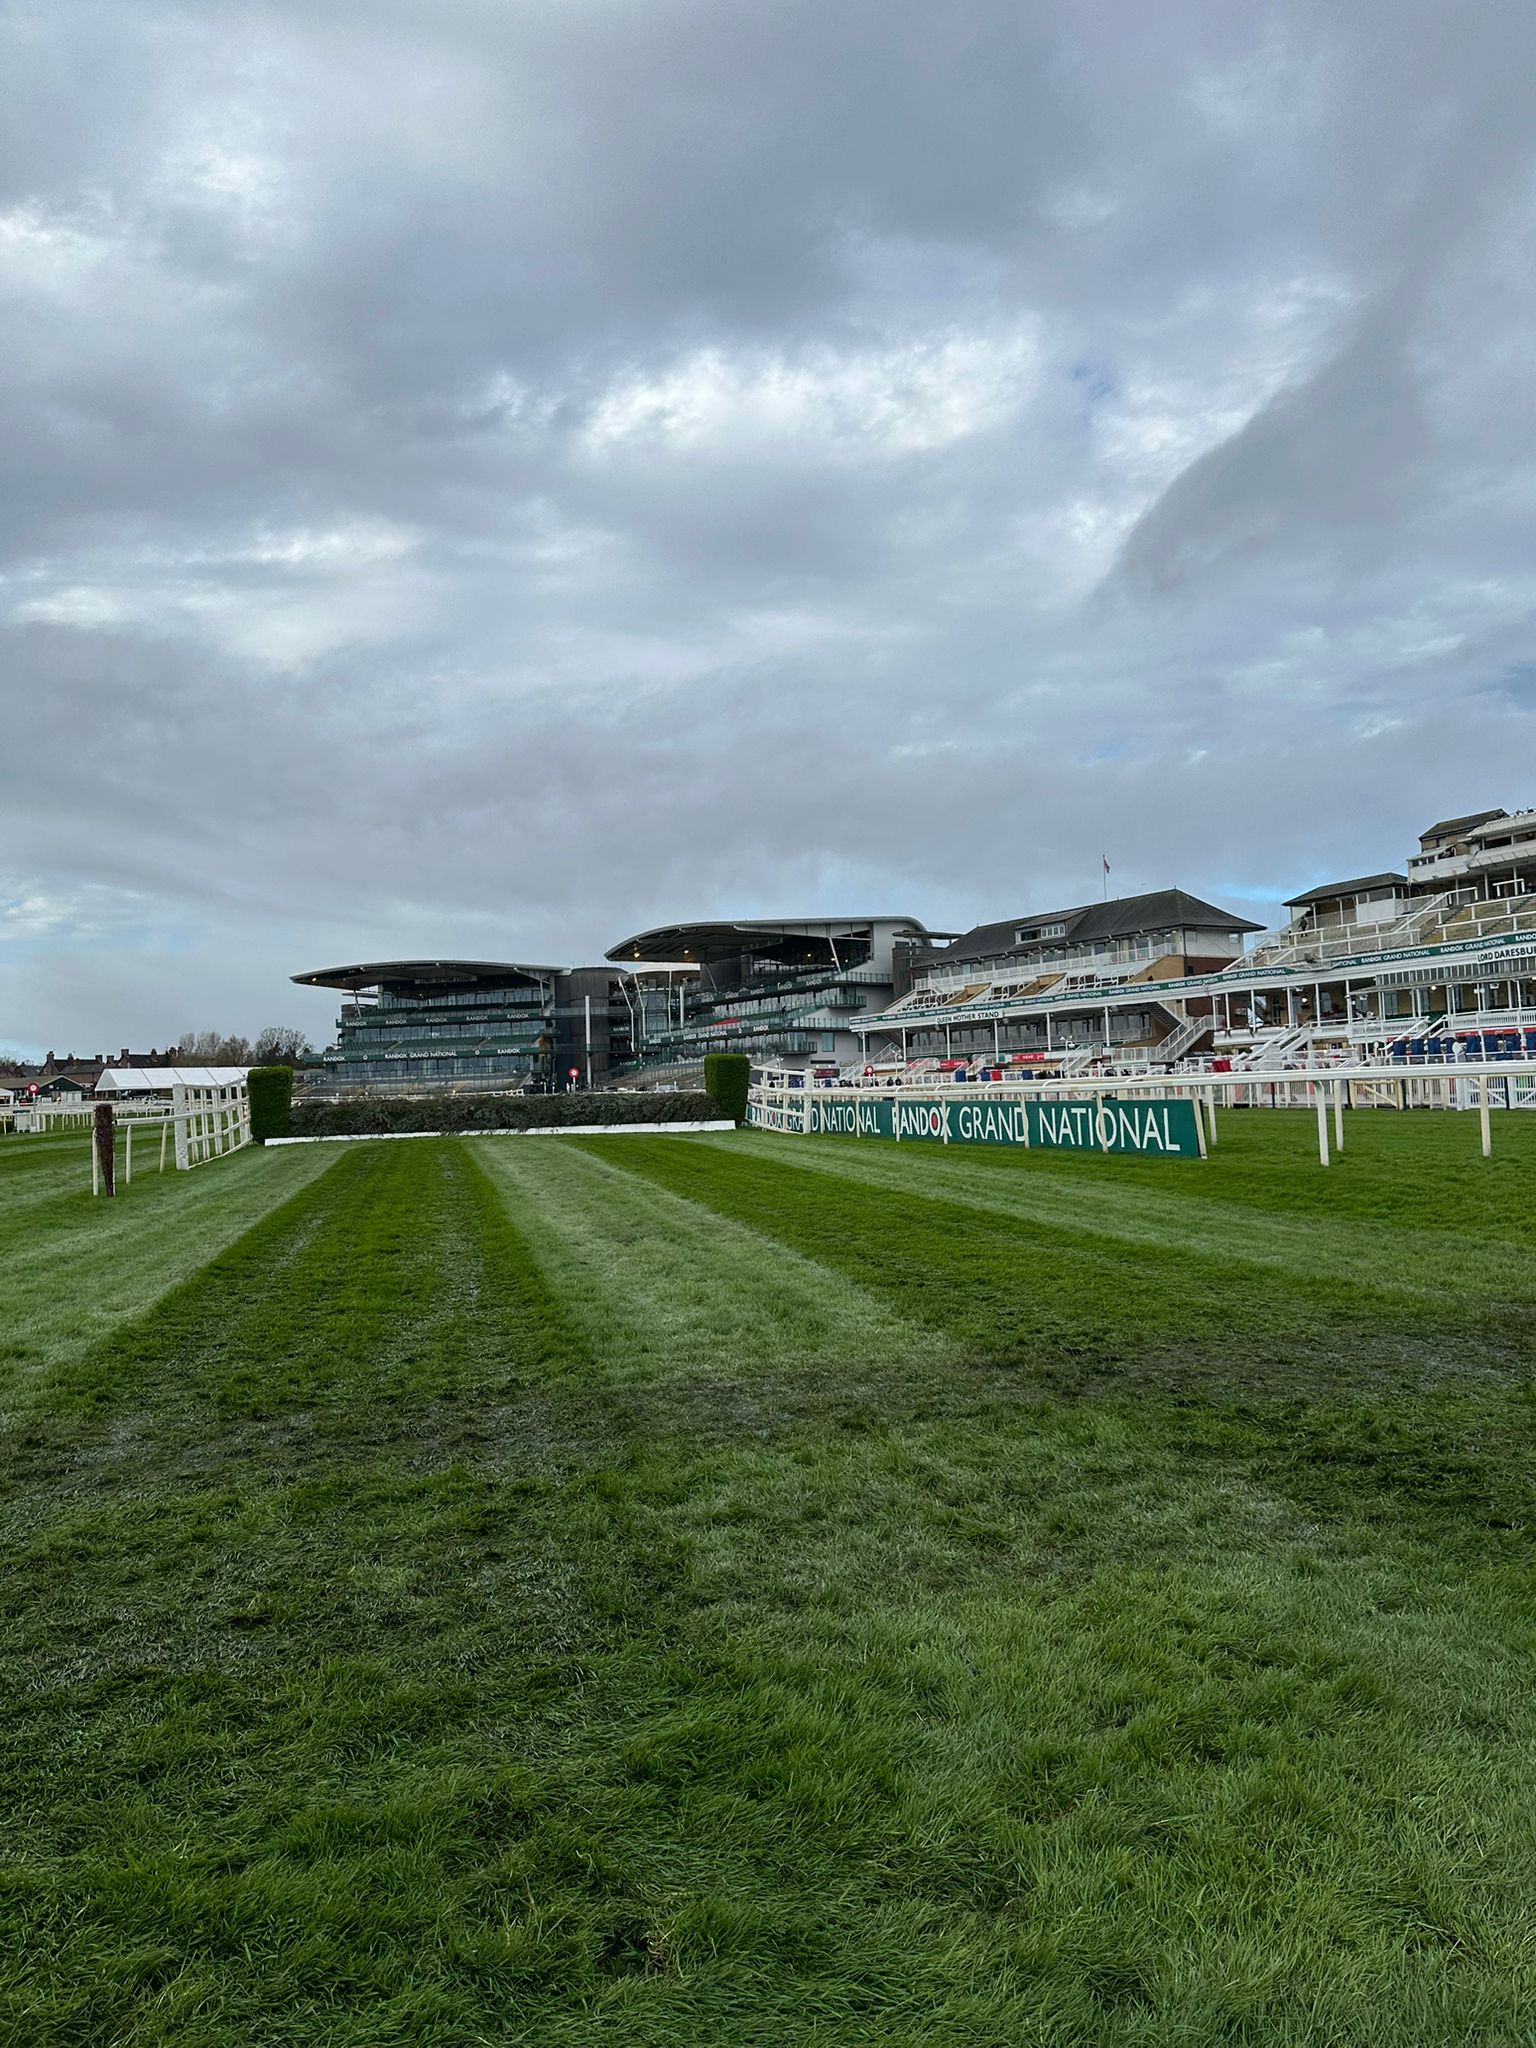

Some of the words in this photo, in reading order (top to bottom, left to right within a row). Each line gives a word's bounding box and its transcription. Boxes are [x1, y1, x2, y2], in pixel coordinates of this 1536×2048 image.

[1515, 932, 1536, 941] RANDO
[1440, 944, 1464, 953] RANDOX
[1477, 952, 1494, 962] LORD
[1495, 945, 1536, 959] DARESBU
[1361, 955, 1382, 963] RANDOX
[1383, 953, 1402, 961] GRAND
[1403, 949, 1430, 959] NATIONAL
[1239, 970, 1256, 978] GRAND
[1257, 968, 1286, 976] NATIONAL
[1140, 984, 1161, 992] NATIONAL
[937, 1016, 952, 1024] QUEEN
[953, 1013, 976, 1022] MOTHER
[977, 1011, 1000, 1019] STAND
[384, 1052, 408, 1060] RANDOX
[409, 1051, 430, 1059] GRAND
[430, 1050, 458, 1058] NATIONAL
[497, 1047, 521, 1055] RANDOX
[323, 1055, 346, 1063] RANDOX
[821, 1105, 881, 1134] NATIONAL
[959, 1105, 1029, 1142] GRAND
[1038, 1107, 1181, 1151] NATIONAL
